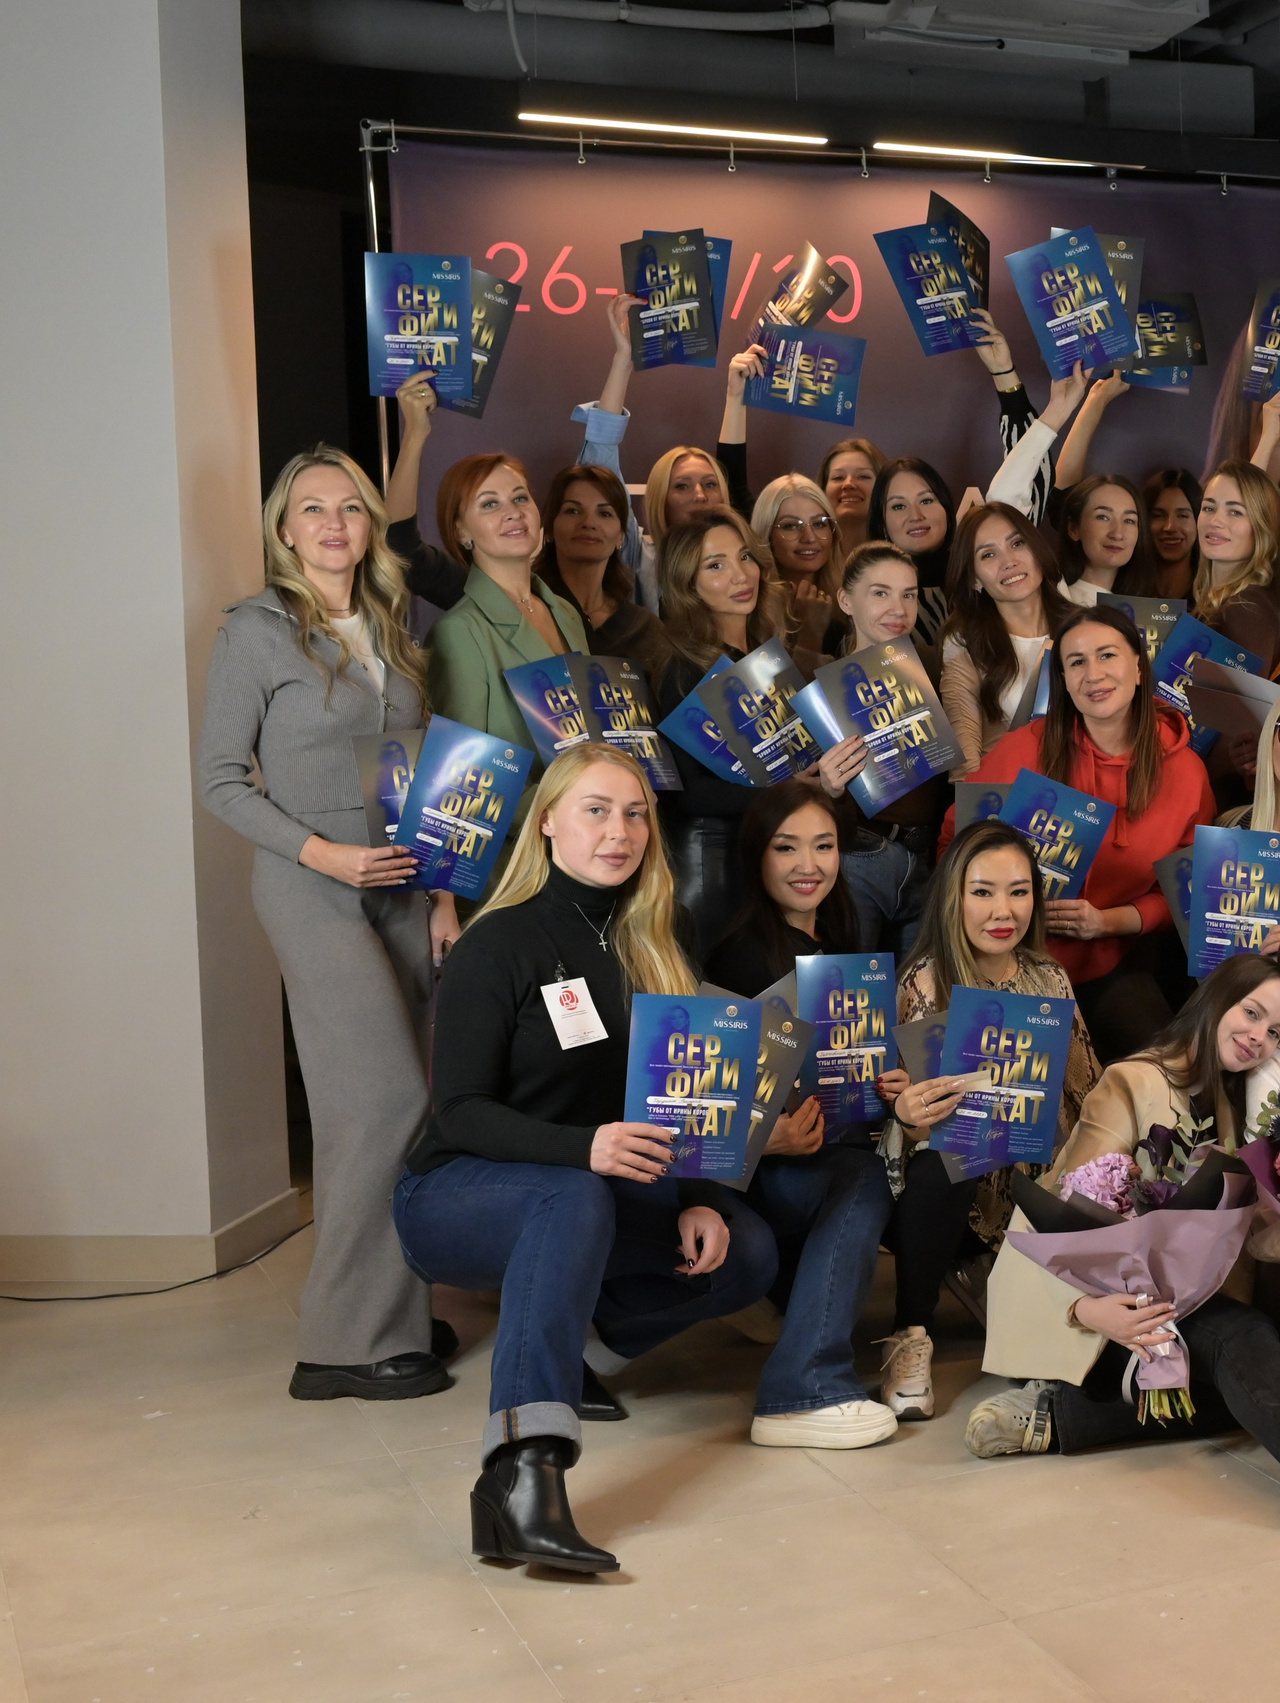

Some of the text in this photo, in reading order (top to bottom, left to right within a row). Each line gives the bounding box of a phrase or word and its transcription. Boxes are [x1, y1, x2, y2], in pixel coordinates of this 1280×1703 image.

[1040, 261, 1079, 294] СЕР
[397, 283, 440, 310] СЕР
[599, 682, 633, 707] СЕР
[854, 670, 897, 706] СЕР
[780, 721, 814, 756] КА
[448, 757, 495, 795] СЕР
[491, 756, 519, 773] MISSIRIS
[1028, 808, 1075, 841] СЕР
[1220, 859, 1264, 889] СЕР
[861, 973, 887, 981] MISSIRIS
[828, 987, 869, 1019] СЕР
[713, 1019, 748, 1029] MISSIRIS
[1025, 1015, 1060, 1026] MISSIRIS
[667, 1031, 722, 1066] СЕР
[766, 1030, 798, 1049] MISSIRIS
[980, 1025, 1033, 1058] СЕР
[847, 1050, 887, 1082] КАТ
[683, 1103, 738, 1136] КАТ
[990, 1091, 1046, 1125] КАТ
